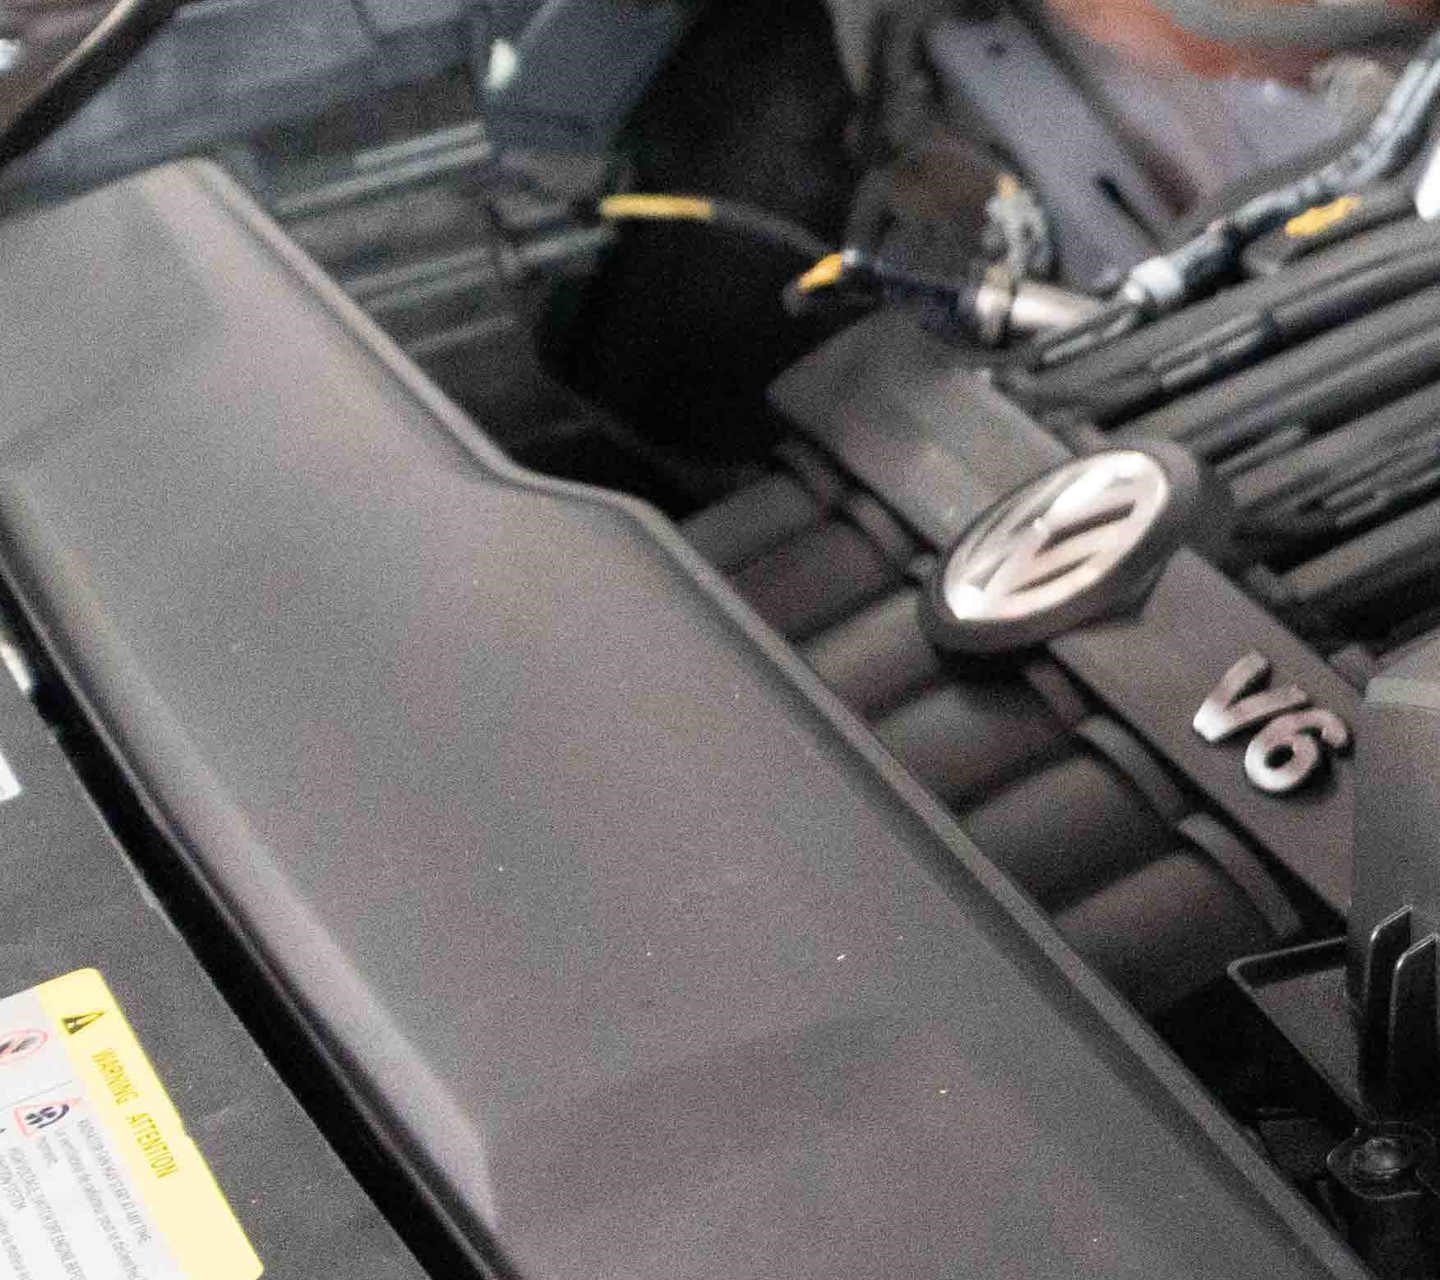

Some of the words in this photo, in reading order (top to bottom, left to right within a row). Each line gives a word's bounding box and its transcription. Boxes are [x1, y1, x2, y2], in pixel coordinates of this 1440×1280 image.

[1193, 650, 1348, 792] V6
[90, 1046, 141, 1106] WARNING
[123, 1108, 180, 1181] ATTENTION
